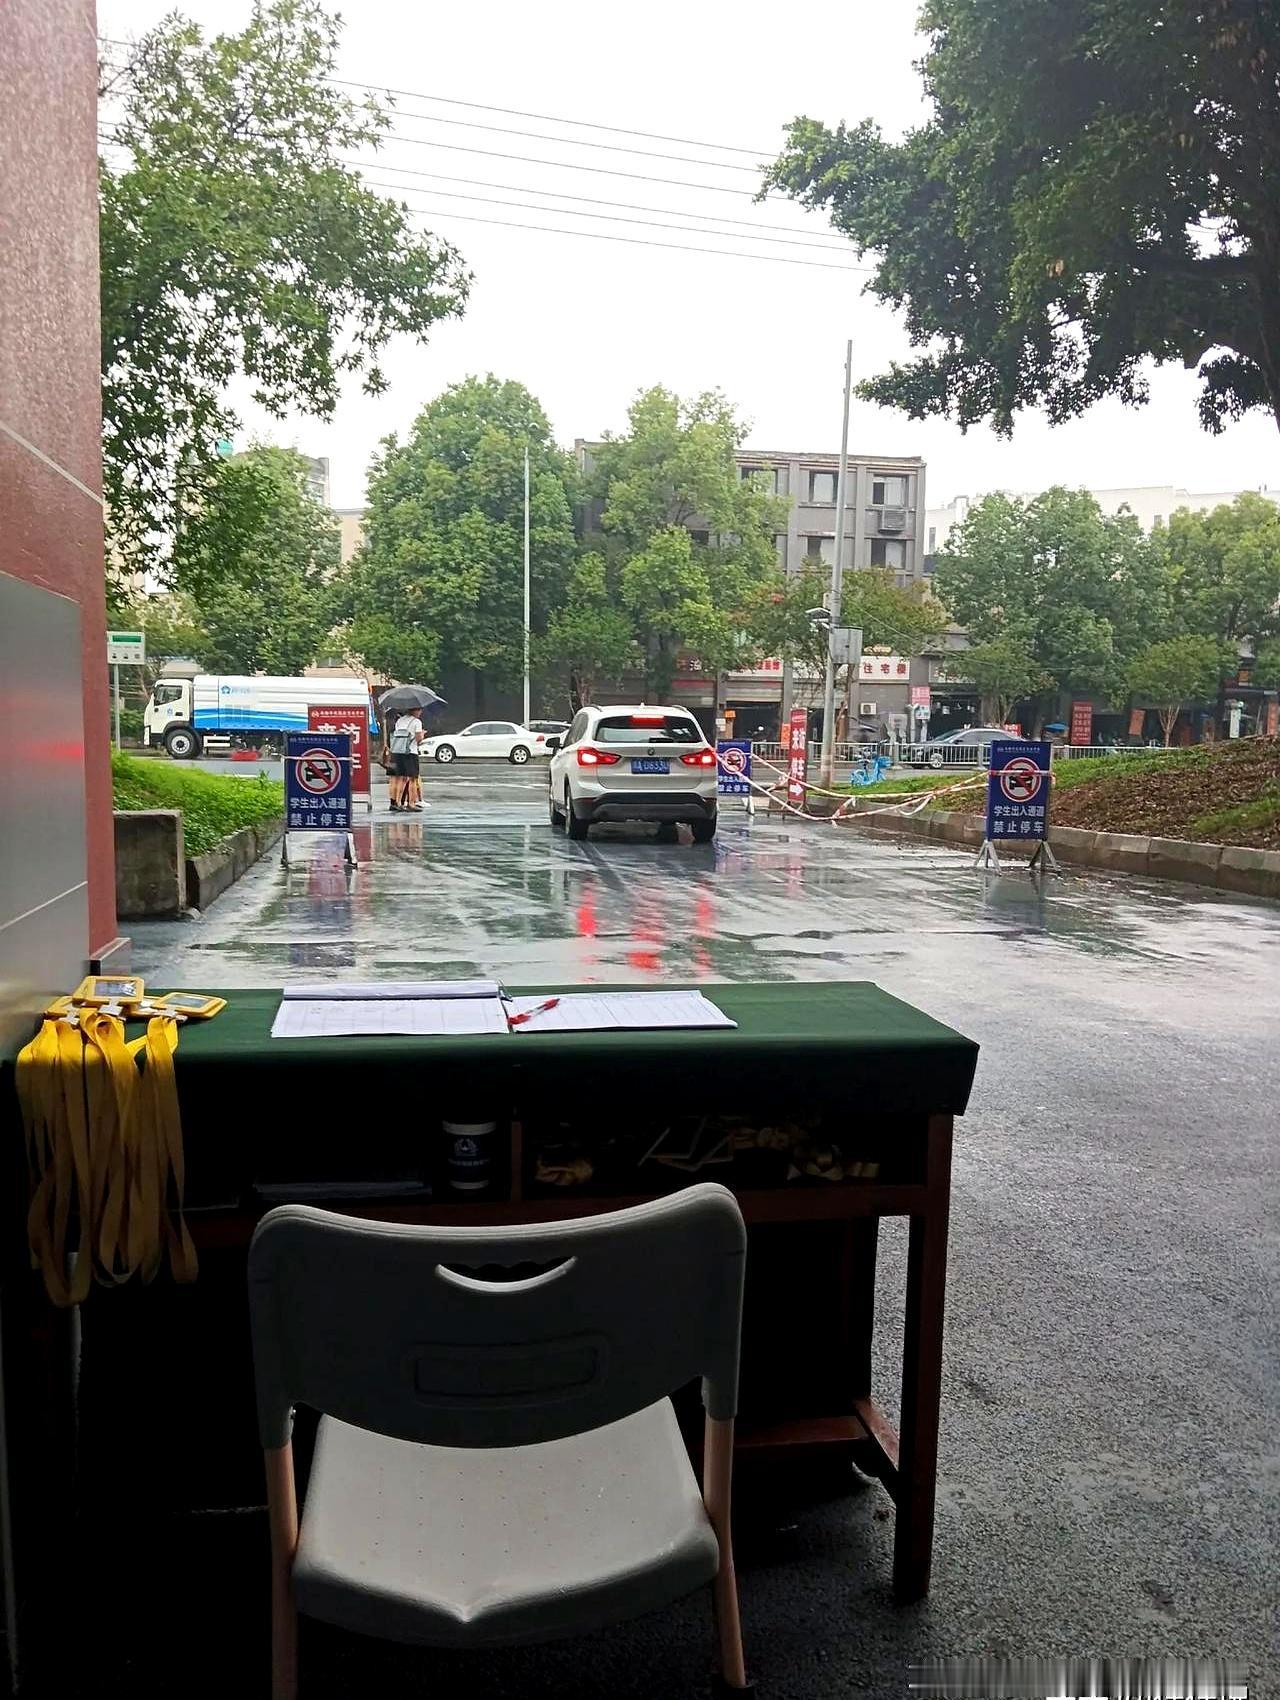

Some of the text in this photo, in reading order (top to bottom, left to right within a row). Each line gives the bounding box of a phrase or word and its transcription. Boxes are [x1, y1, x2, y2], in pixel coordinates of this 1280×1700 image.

[290, 797, 347, 809] 学生出入通道
[993, 805, 1045, 817] 学生出入通道
[290, 813, 347, 826] 禁止停车
[993, 820, 1044, 834] 禁止停车
